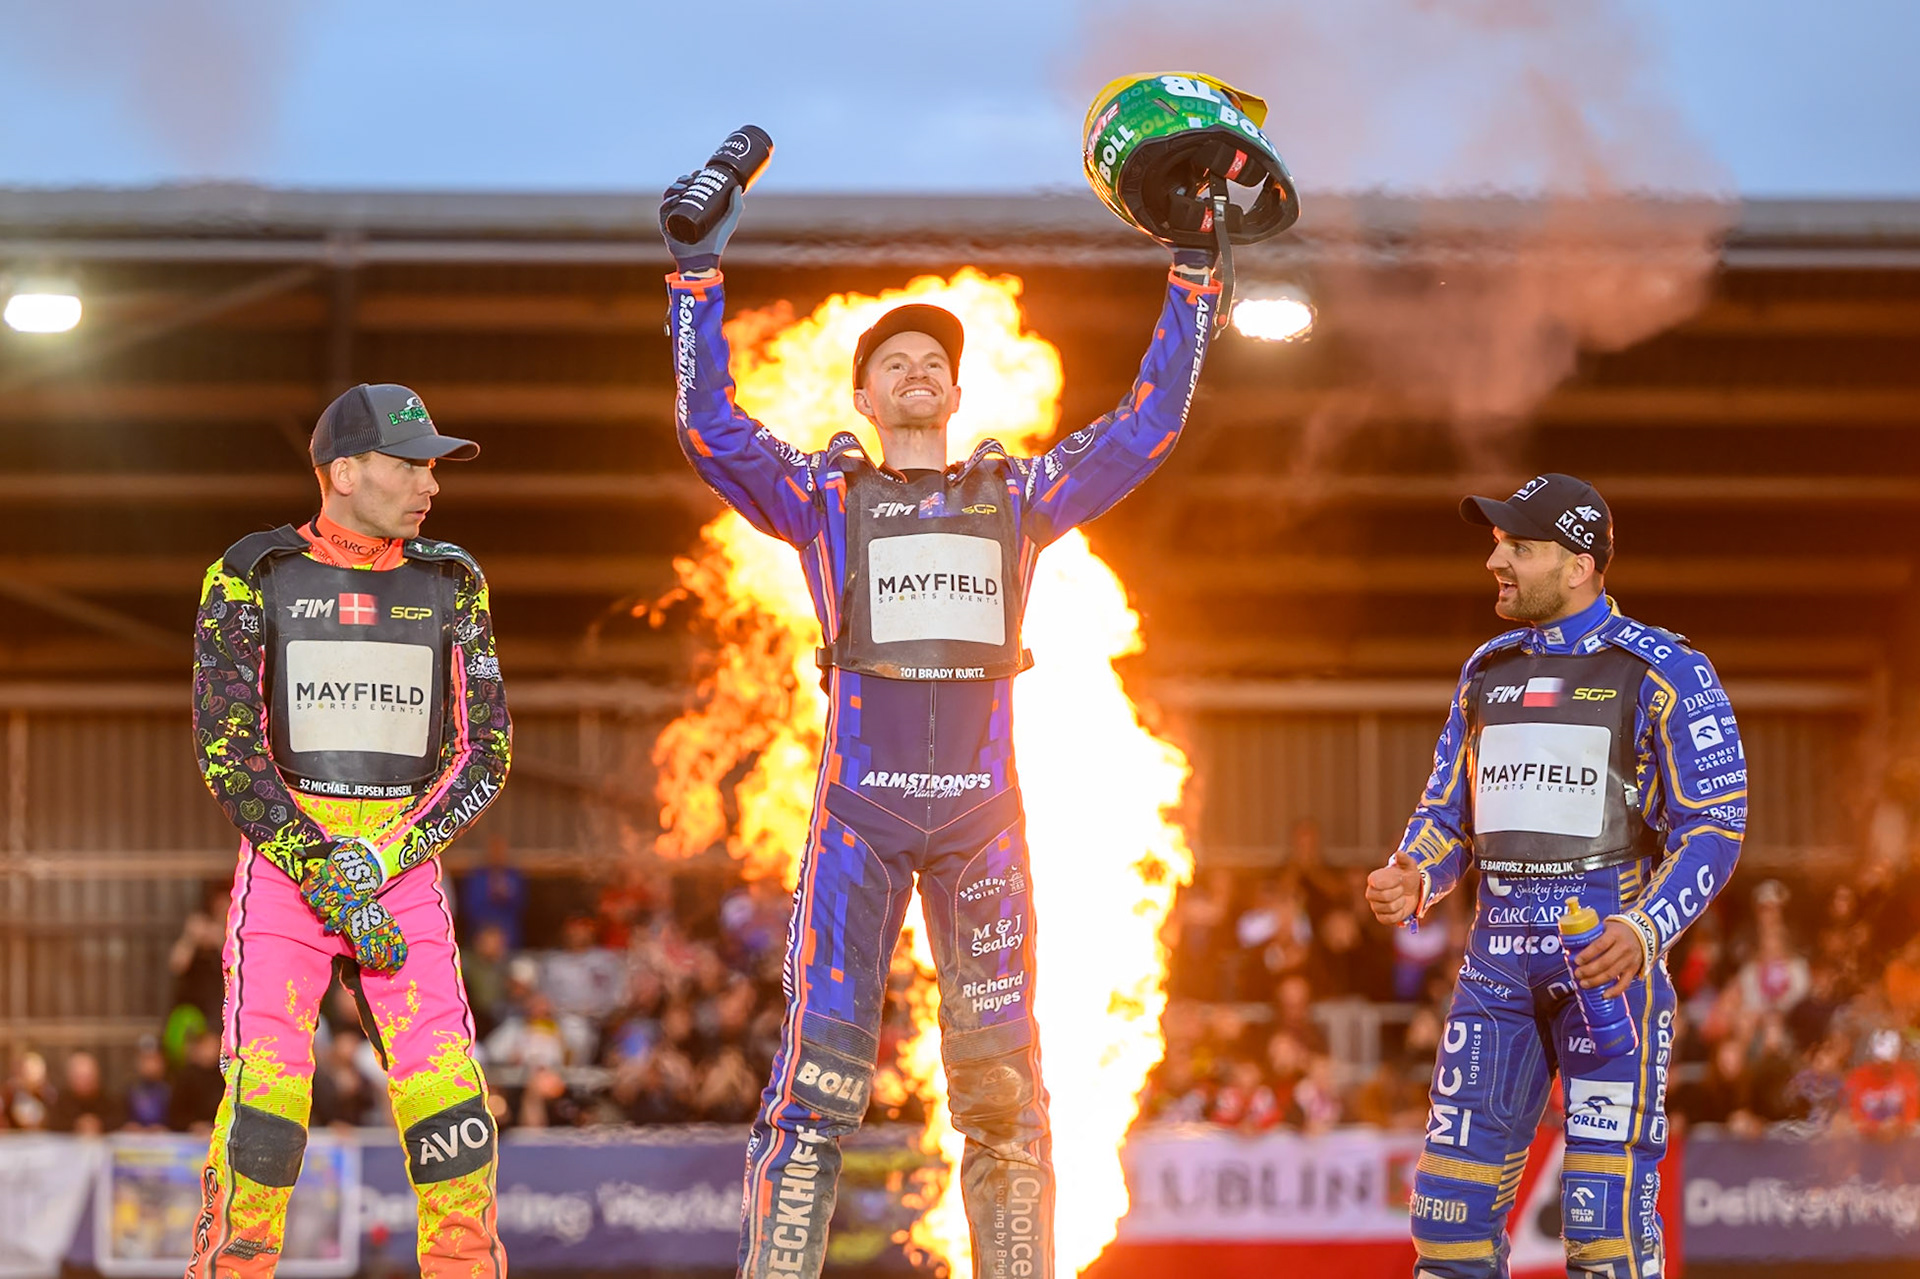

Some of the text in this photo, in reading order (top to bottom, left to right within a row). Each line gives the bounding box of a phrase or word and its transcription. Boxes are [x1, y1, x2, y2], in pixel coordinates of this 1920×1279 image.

[1098, 124, 1136, 184] BOLL
[868, 502, 998, 519] FIM SGP
[1574, 504, 1602, 522] 4F
[878, 573, 998, 596] MAYFIELD
[286, 599, 433, 620] FIM SGP
[878, 593, 998, 605] SPORTS EVENTS
[1617, 625, 1673, 660] MCG
[918, 668, 954, 679] BRADY
[955, 667, 985, 679] KURTZ
[296, 681, 425, 706] MAYFIELD
[1486, 685, 1617, 704] FIM SGP
[296, 702, 424, 716] SPORTS EVENTS
[1694, 746, 1736, 765] PROMET
[1697, 755, 1734, 772] CARGO
[859, 771, 991, 790] ARMSTRONG'S
[1481, 763, 1599, 787] MAYFIELD
[299, 778, 412, 797] 52 MICHAEL JEPSEN JENSEN
[1536, 784, 1597, 796] EVENTS
[399, 772, 498, 871] GARCAREK
[333, 849, 380, 895] FIST
[1487, 860, 1524, 873] BARTOSZ
[1524, 861, 1575, 874] ZMARZLIK
[959, 878, 1007, 899] EASTERN
[967, 887, 1001, 902] POINT
[1649, 864, 1715, 946] MCG
[971, 913, 1023, 943] M & J
[971, 931, 1024, 958] Sealey
[962, 970, 1025, 999] Richard
[972, 990, 1022, 1014] Hayes
[1467, 1030, 1483, 1086] Logistics
[795, 1060, 866, 1104] BOLL
[1428, 1021, 1470, 1147] MCG
[1572, 1113, 1619, 1132] ORLEN
[419, 1116, 490, 1166] AVO
[1570, 1207, 1595, 1218] ORLEN
[1571, 1214, 1594, 1224] TEAM
[1639, 1172, 1655, 1257] lubelskie
[1010, 1176, 1041, 1279] Choice
[993, 1233, 1008, 1248] by
